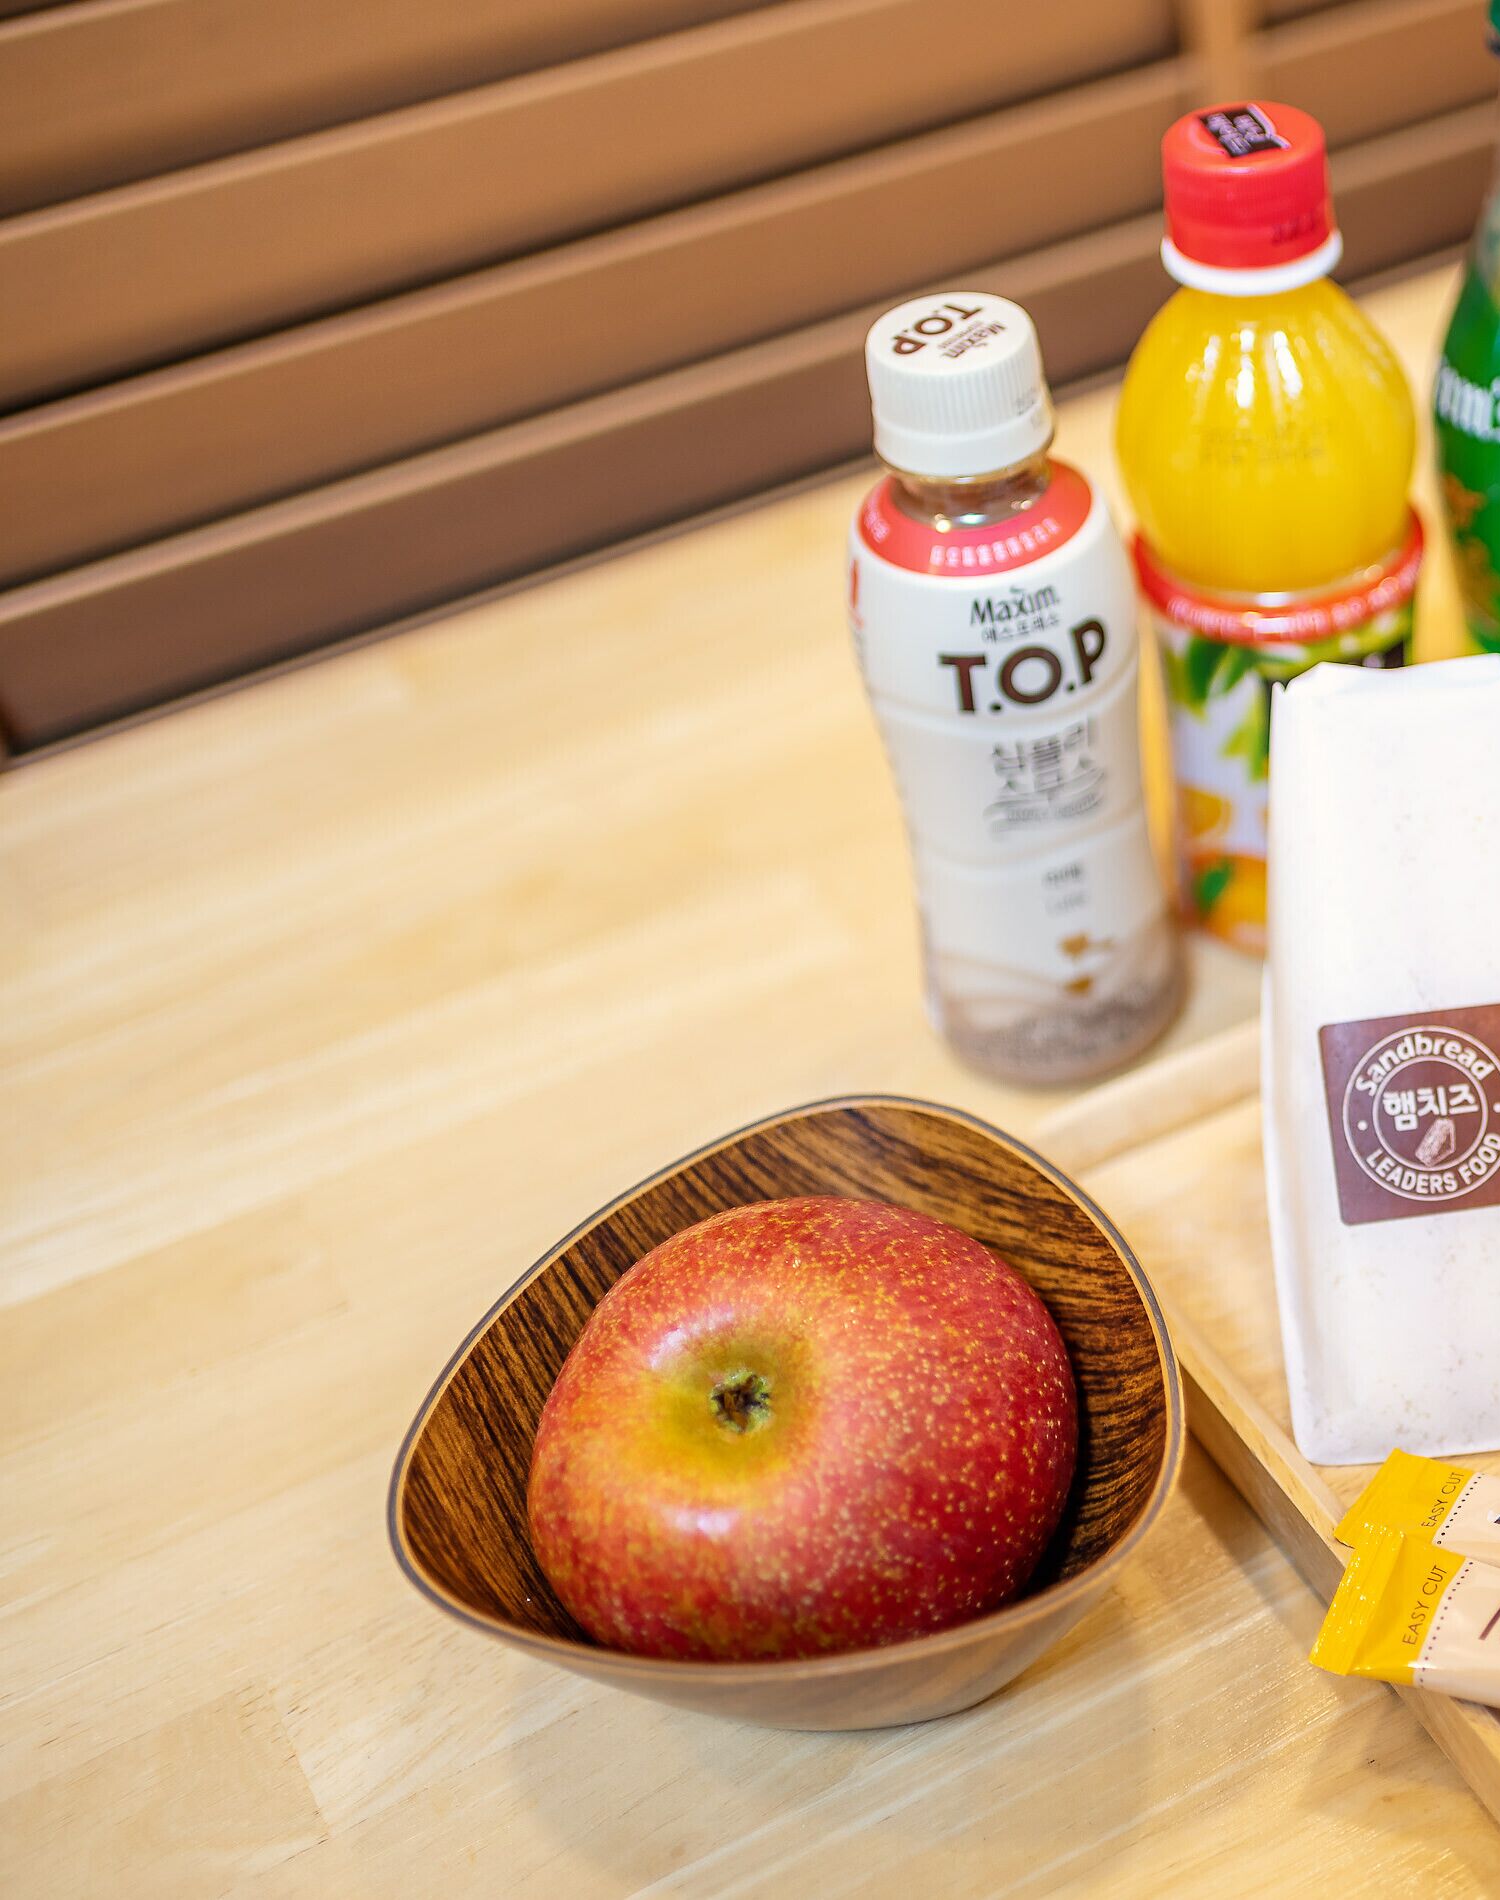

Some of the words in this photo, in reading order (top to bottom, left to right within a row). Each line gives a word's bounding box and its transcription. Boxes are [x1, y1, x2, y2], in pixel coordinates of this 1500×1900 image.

[970, 586, 1060, 627] Maxim
[938, 616, 1107, 713] T.O.P
[1356, 1032, 1497, 1097] Sandbread
[1382, 1082, 1480, 1132] 햄치즈
[1366, 1149, 1458, 1195] LEADERS
[1420, 1498, 1450, 1529] EASY
[1441, 1471, 1466, 1495] CUT
[1401, 1601, 1432, 1646] EASY
[1422, 1564, 1450, 1598] CUT
